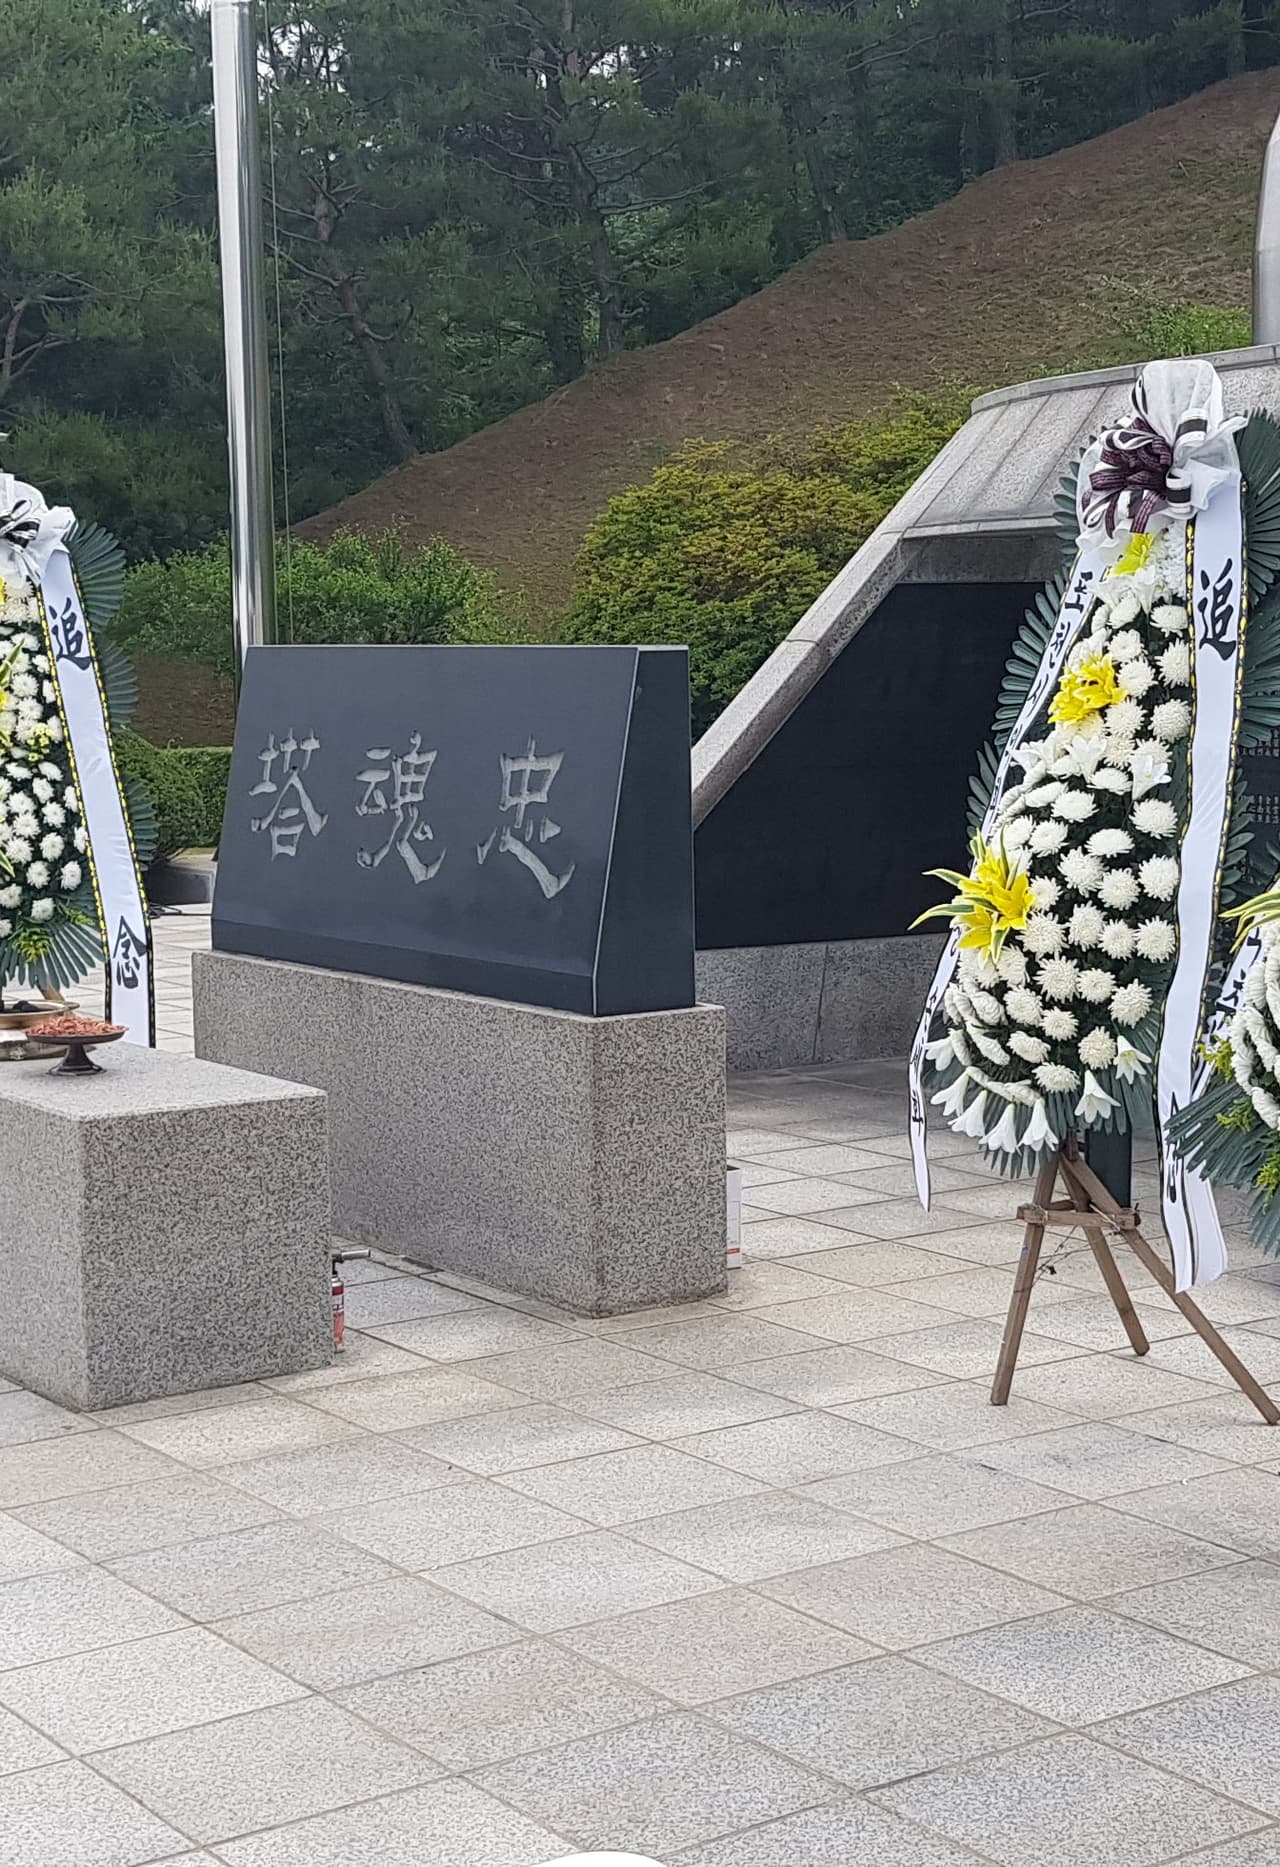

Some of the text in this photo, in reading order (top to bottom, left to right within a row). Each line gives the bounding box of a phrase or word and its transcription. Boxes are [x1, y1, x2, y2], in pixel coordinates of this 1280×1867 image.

[1197, 557, 1237, 662] 追
[49, 597, 148, 990] 追 念
